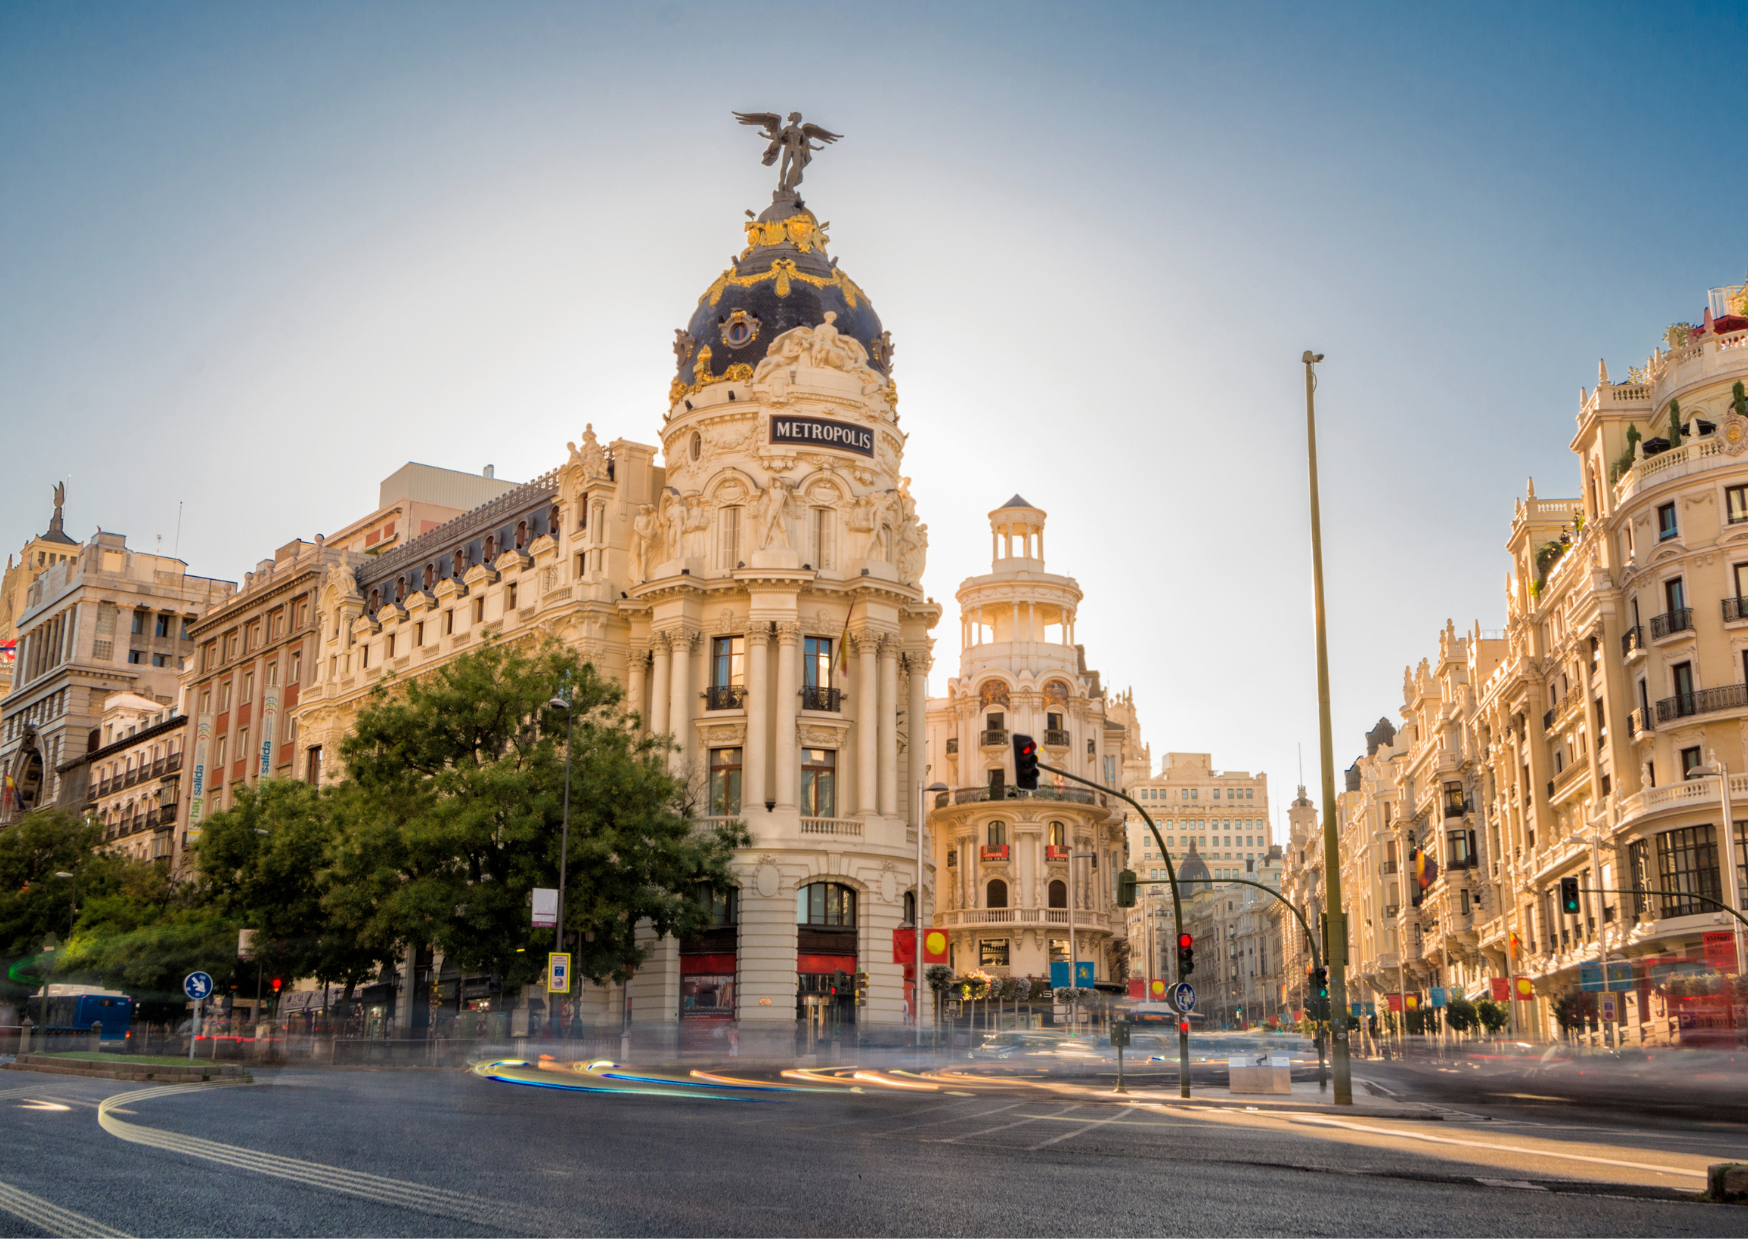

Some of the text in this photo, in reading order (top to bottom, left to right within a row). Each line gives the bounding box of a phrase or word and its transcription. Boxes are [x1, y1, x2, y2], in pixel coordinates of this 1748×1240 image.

[777, 422, 871, 449] METROPOLIS
[261, 741, 271, 774] salida
[193, 765, 204, 796] salida
[190, 798, 203, 818] hay
[1680, 1013, 1691, 1027] P
